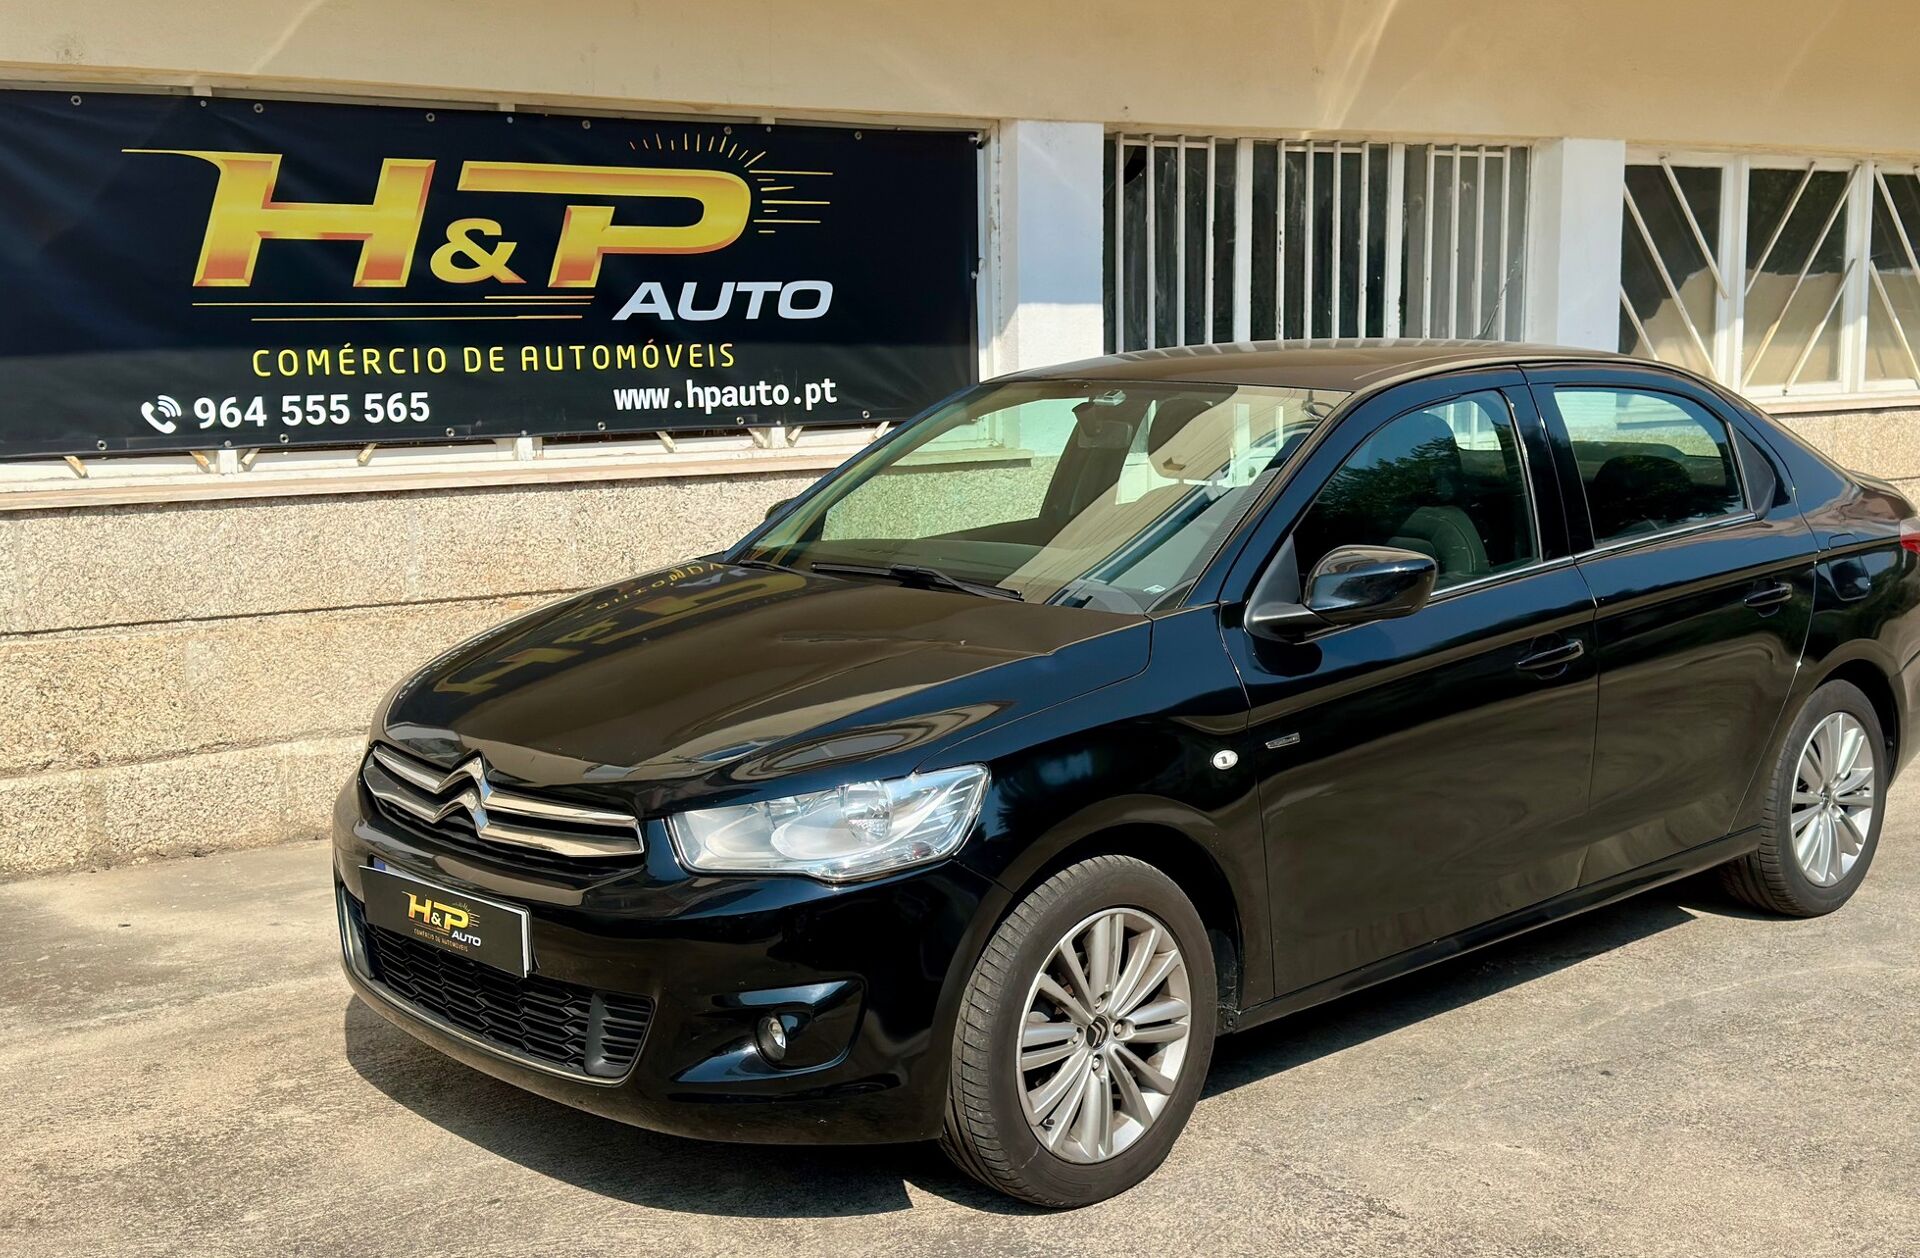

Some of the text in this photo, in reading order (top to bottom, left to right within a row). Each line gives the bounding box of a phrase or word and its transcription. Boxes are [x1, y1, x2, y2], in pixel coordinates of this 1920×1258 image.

[180, 149, 752, 289] H&P
[611, 279, 834, 322] AUTO
[252, 338, 735, 377] COMÉRCIO DE AUTOMÓVEIS
[193, 391, 430, 430] 964 555 565
[612, 378, 838, 415] www.hpauto.pt
[407, 894, 469, 931] H&P
[451, 930, 482, 947] AUTO
